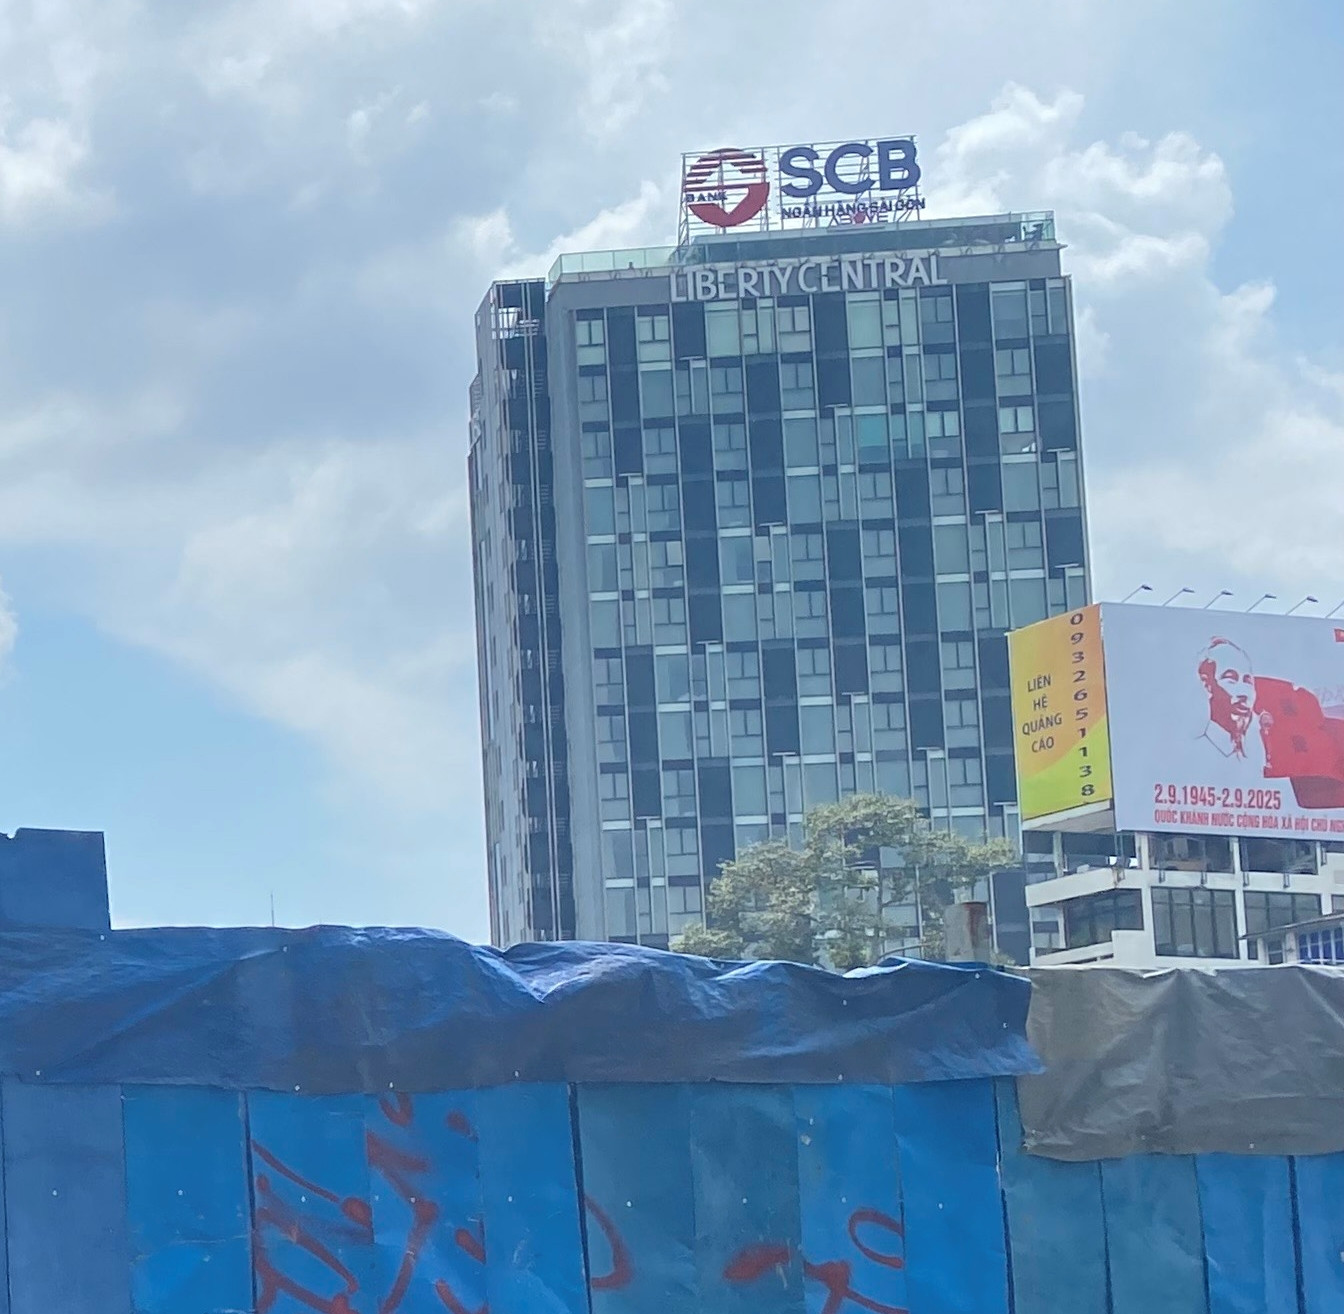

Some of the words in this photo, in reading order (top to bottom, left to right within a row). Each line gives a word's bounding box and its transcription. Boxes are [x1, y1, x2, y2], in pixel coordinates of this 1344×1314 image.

[779, 139, 922, 198] SCB
[670, 265, 792, 302] LIBERTY
[797, 254, 949, 293] CENTRAL
[1027, 674, 1052, 693] LIÊN
[1031, 736, 1055, 753] CÁO
[1154, 783, 1281, 811] 2.9.1945-2.9.2025
